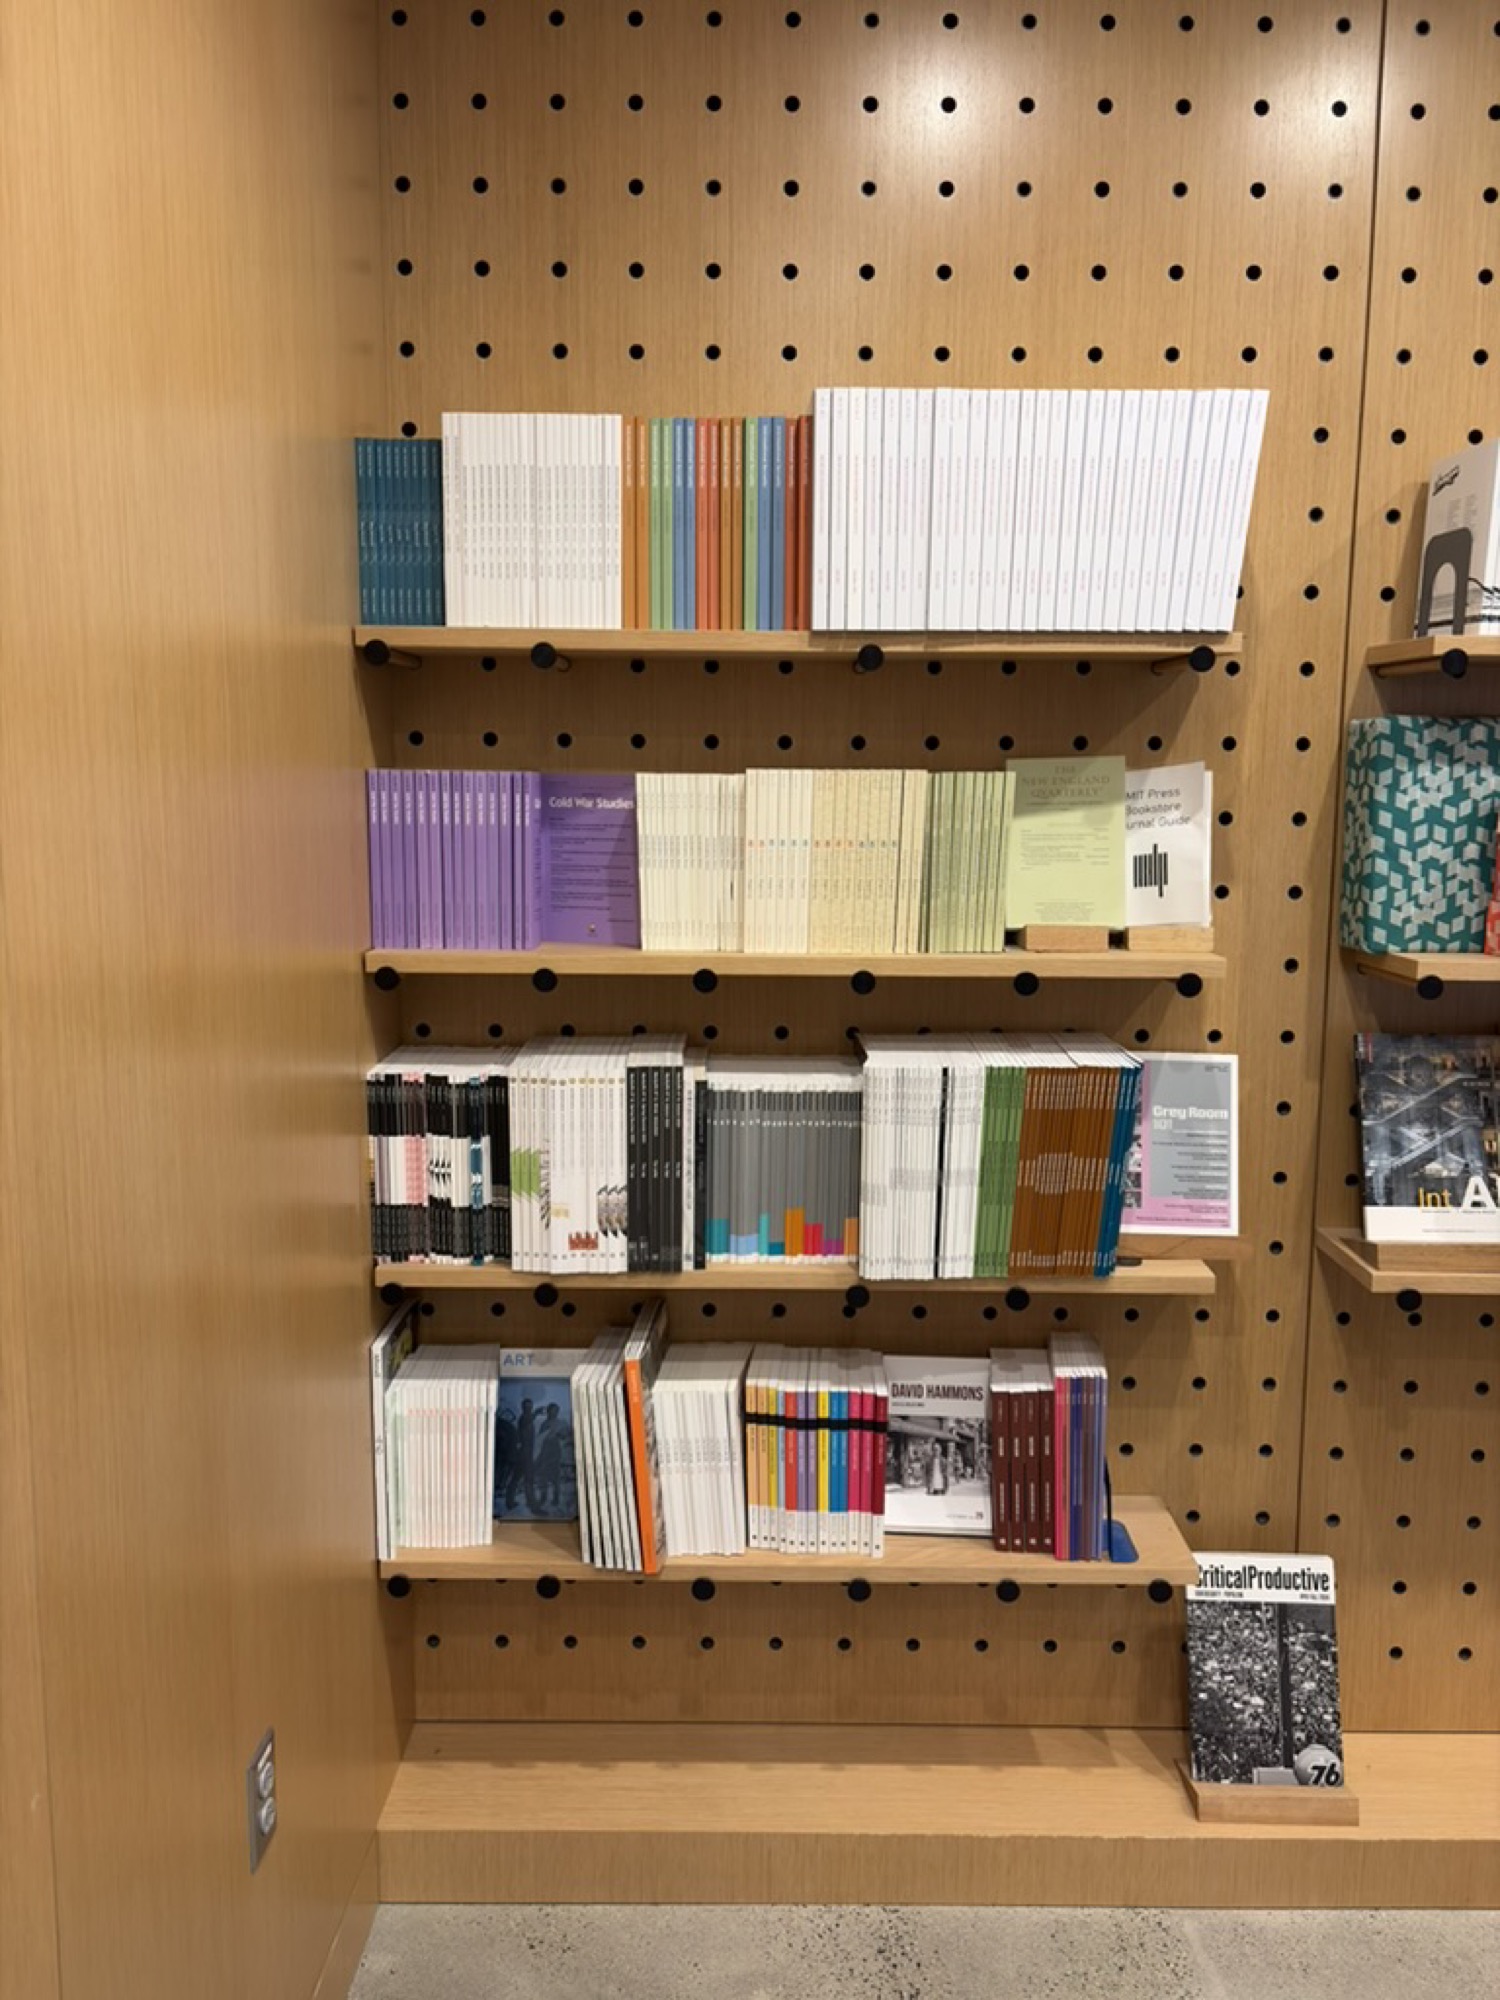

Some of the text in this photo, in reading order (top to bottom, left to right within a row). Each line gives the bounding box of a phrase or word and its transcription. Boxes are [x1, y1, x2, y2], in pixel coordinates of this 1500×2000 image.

[1022, 775, 1110, 786] NEW ENGLAND
[1031, 787, 1102, 799] QUARTERLY
[1148, 788, 1180, 798] Press
[549, 797, 572, 808] Cold
[574, 797, 594, 808] War
[1126, 816, 1191, 830] urnal Guide
[1153, 1105, 1229, 1120] Grey Room
[892, 1382, 984, 1401] DAVID HAMMONS
[1311, 1762, 1340, 1786] 76
